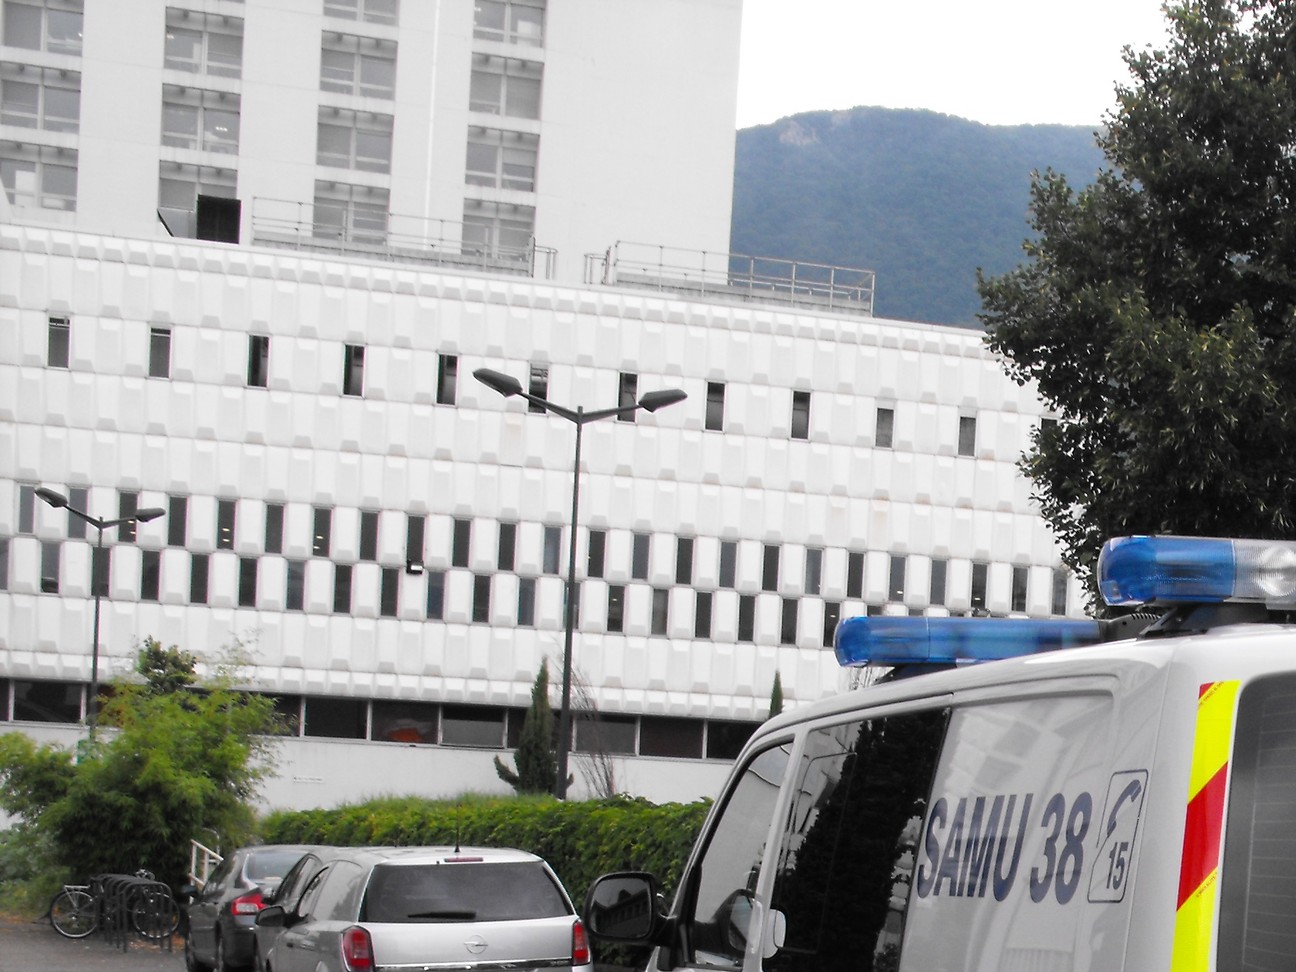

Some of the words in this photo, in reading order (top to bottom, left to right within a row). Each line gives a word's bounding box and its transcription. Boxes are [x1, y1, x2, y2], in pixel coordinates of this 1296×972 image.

[917, 793, 1034, 902] SAMU
[1029, 792, 1093, 905] 38
[1106, 842, 1129, 890] 15
